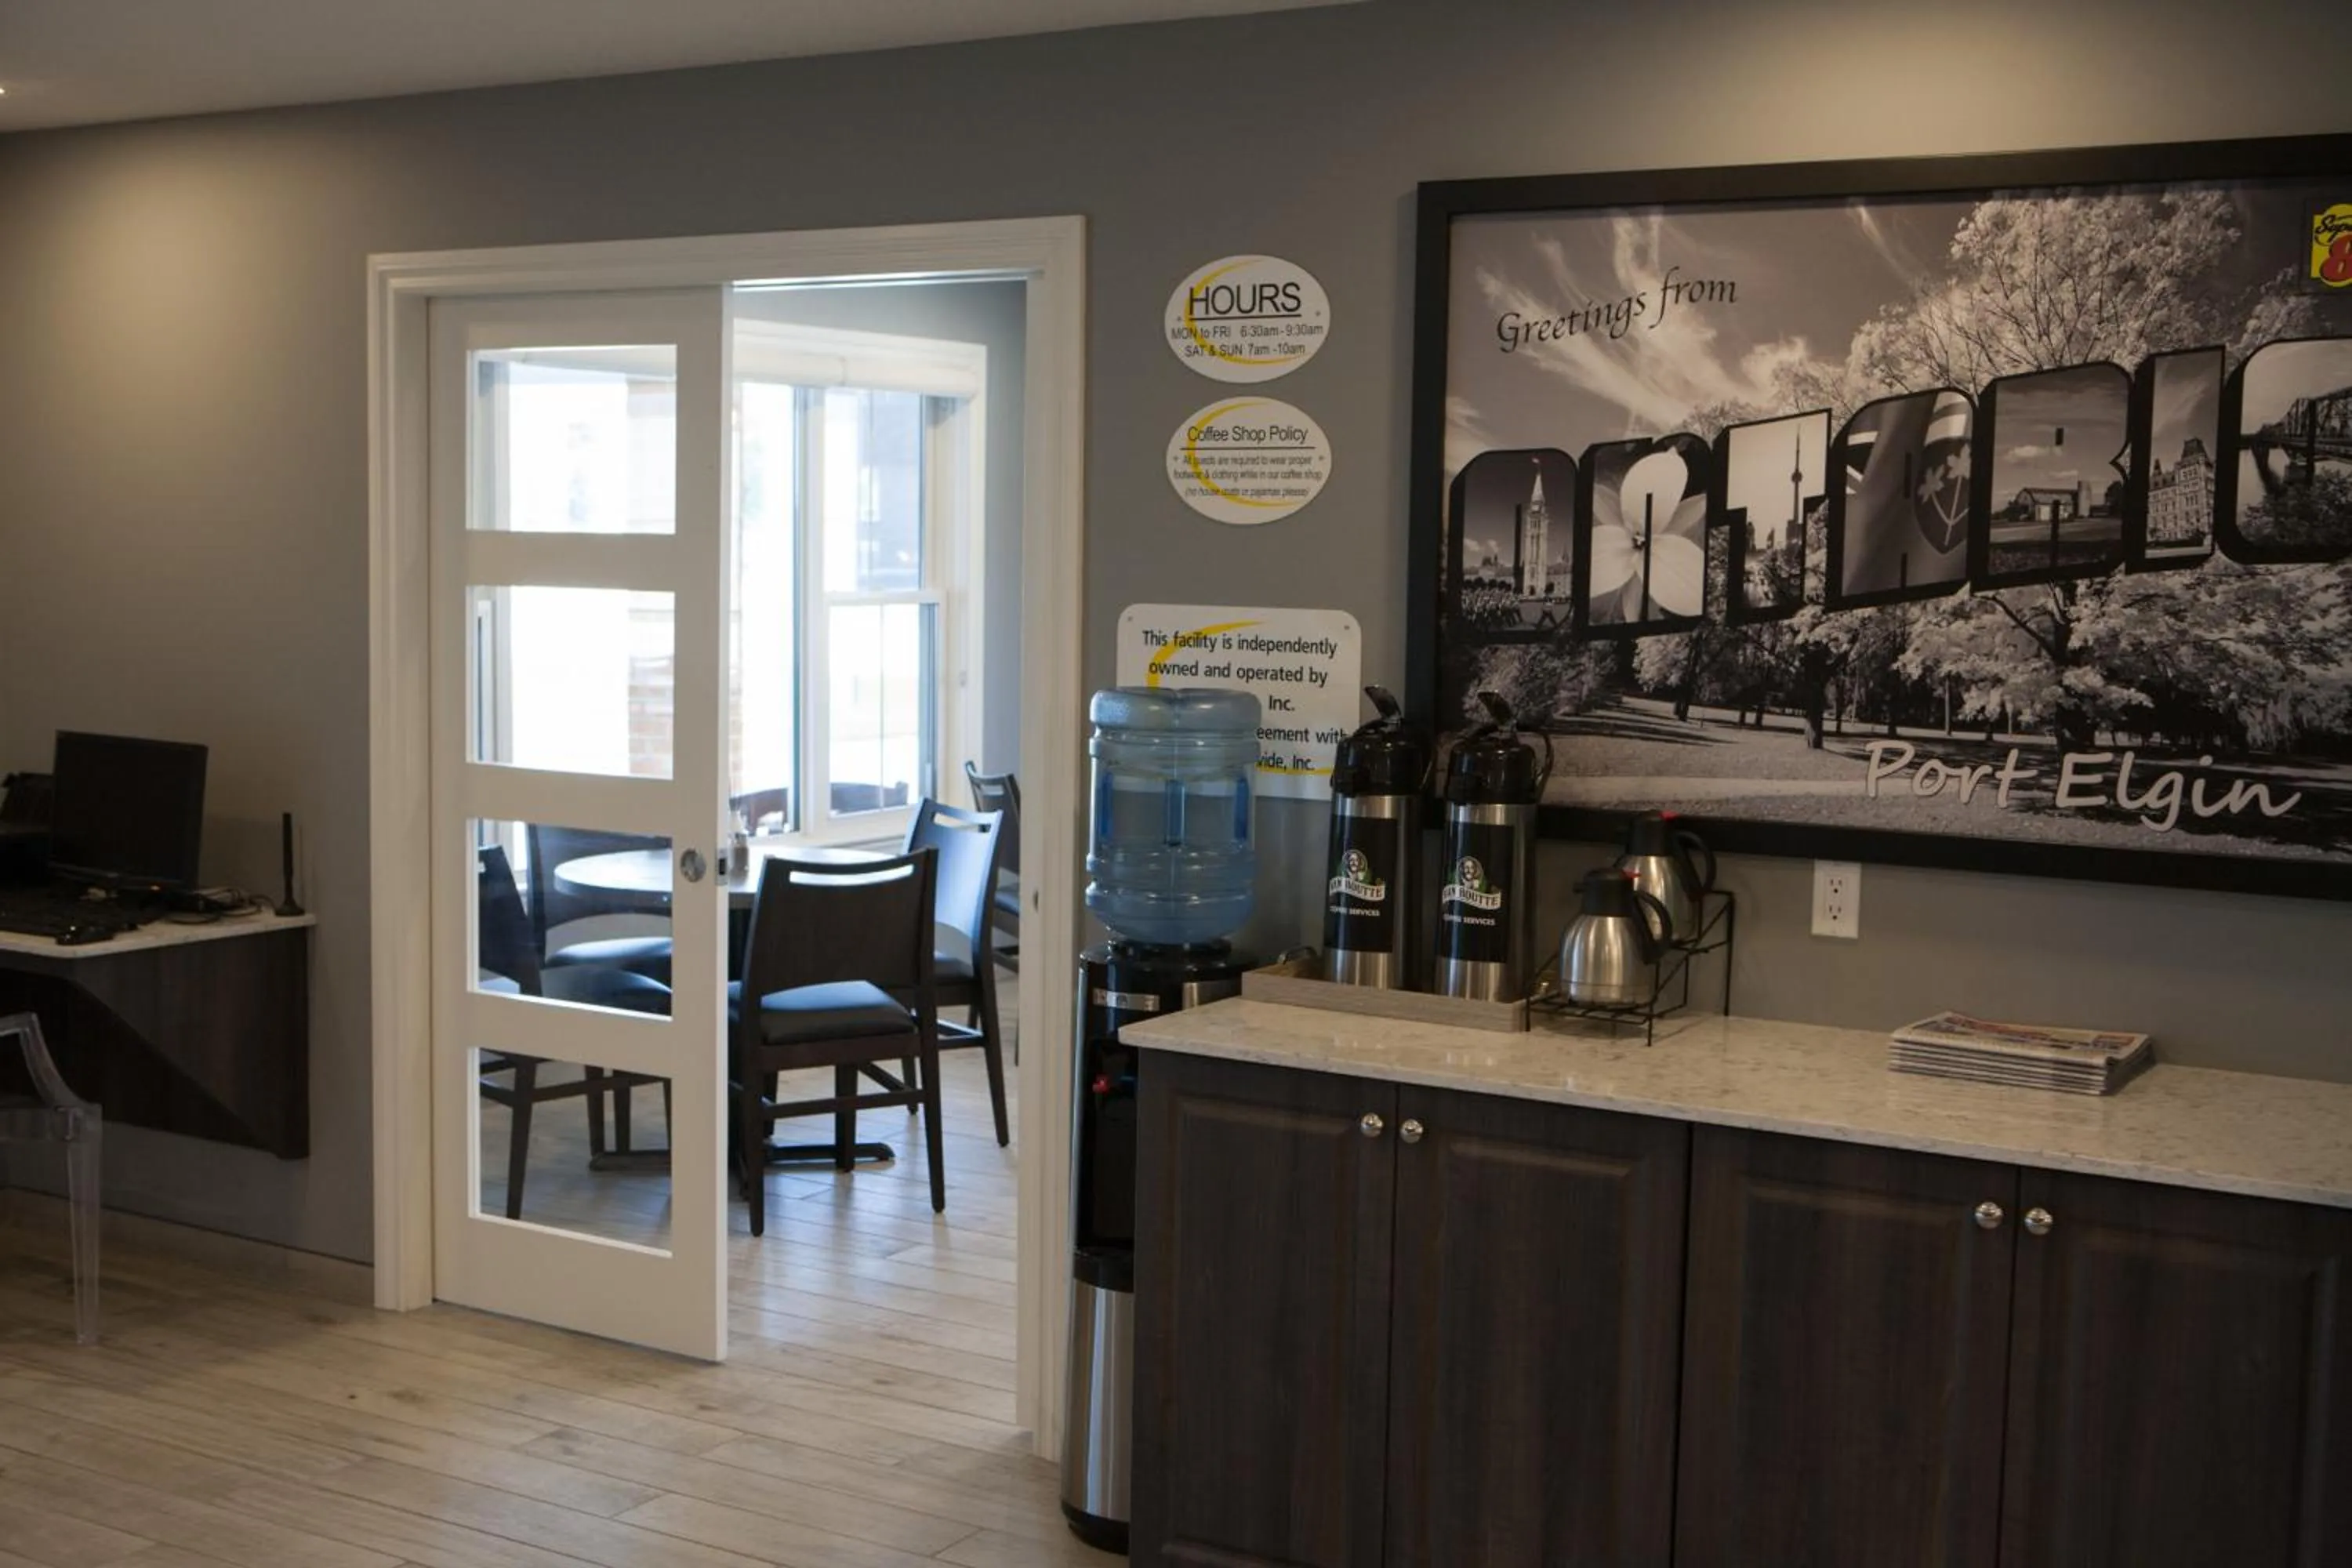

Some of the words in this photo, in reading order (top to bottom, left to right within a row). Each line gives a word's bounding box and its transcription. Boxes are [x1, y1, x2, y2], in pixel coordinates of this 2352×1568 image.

[2319, 231, 2352, 283] 8
[1189, 282, 1301, 315] HOURS
[1497, 292, 1646, 353] Greetings
[1649, 266, 1737, 329] from
[1171, 326, 1196, 339] MON
[1200, 326, 1210, 338] to
[1213, 325, 1231, 338] FRI
[1240, 325, 1279, 338] 6:30am
[1286, 324, 1323, 336] 9:30am
[1185, 345, 1204, 358] SAT
[1210, 344, 1216, 356] &
[1219, 343, 1243, 357] SUN
[1248, 343, 1269, 355] 7am
[1188, 426, 1229, 442] Coffee
[1232, 426, 1266, 444] Shop
[1269, 425, 1308, 445] Policy
[1142, 630, 1167, 647] This
[1174, 630, 1217, 652] facility
[1222, 633, 1232, 649] is
[1238, 634, 1338, 659] independently
[1149, 662, 1198, 677] owned
[1204, 662, 1230, 678] and
[1236, 666, 1303, 684] operated
[1309, 667, 1327, 688] by
[1269, 695, 1295, 711] Inc.
[1256, 726, 1309, 742] eement
[1292, 754, 1316, 771] Inc.
[1865, 740, 2038, 809] Port
[2055, 750, 2302, 832] Elgin
